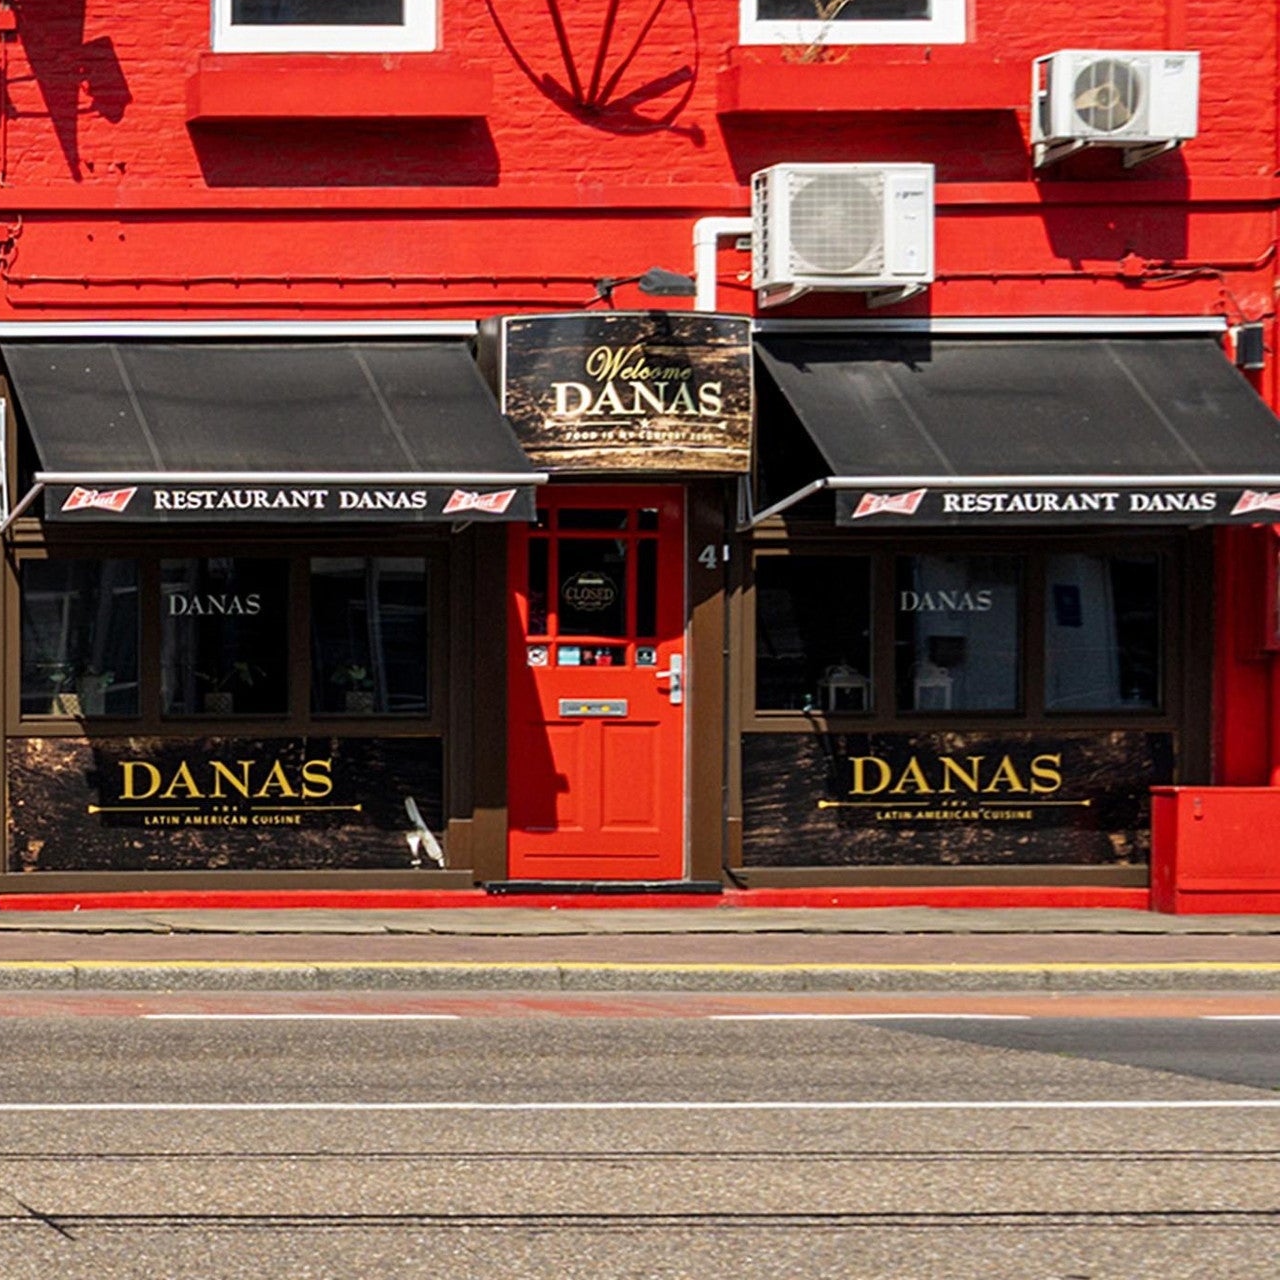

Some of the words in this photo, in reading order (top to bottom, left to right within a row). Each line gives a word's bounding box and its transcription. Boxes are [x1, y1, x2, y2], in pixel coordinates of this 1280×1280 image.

[585, 343, 692, 383] Welcome
[550, 380, 723, 417] DANAS
[77, 488, 118, 508] Bud
[153, 489, 328, 510] RESTAURANT
[339, 490, 428, 510] DANAS
[942, 492, 1120, 513] RESTAURANT
[1129, 491, 1218, 512] DANAS
[169, 593, 262, 616] DANAS
[565, 587, 615, 601] CLOSED
[900, 589, 993, 612] DANAS
[117, 757, 334, 801] DANAS
[848, 752, 1063, 796] DANAS
[144, 814, 181, 826] LATIN
[184, 813, 248, 826] AMERICAN
[252, 813, 302, 825] CUISINE
[876, 811, 913, 821] LATIN
[916, 810, 979, 821] AMERICAN
[983, 809, 1033, 821] CUISINE
